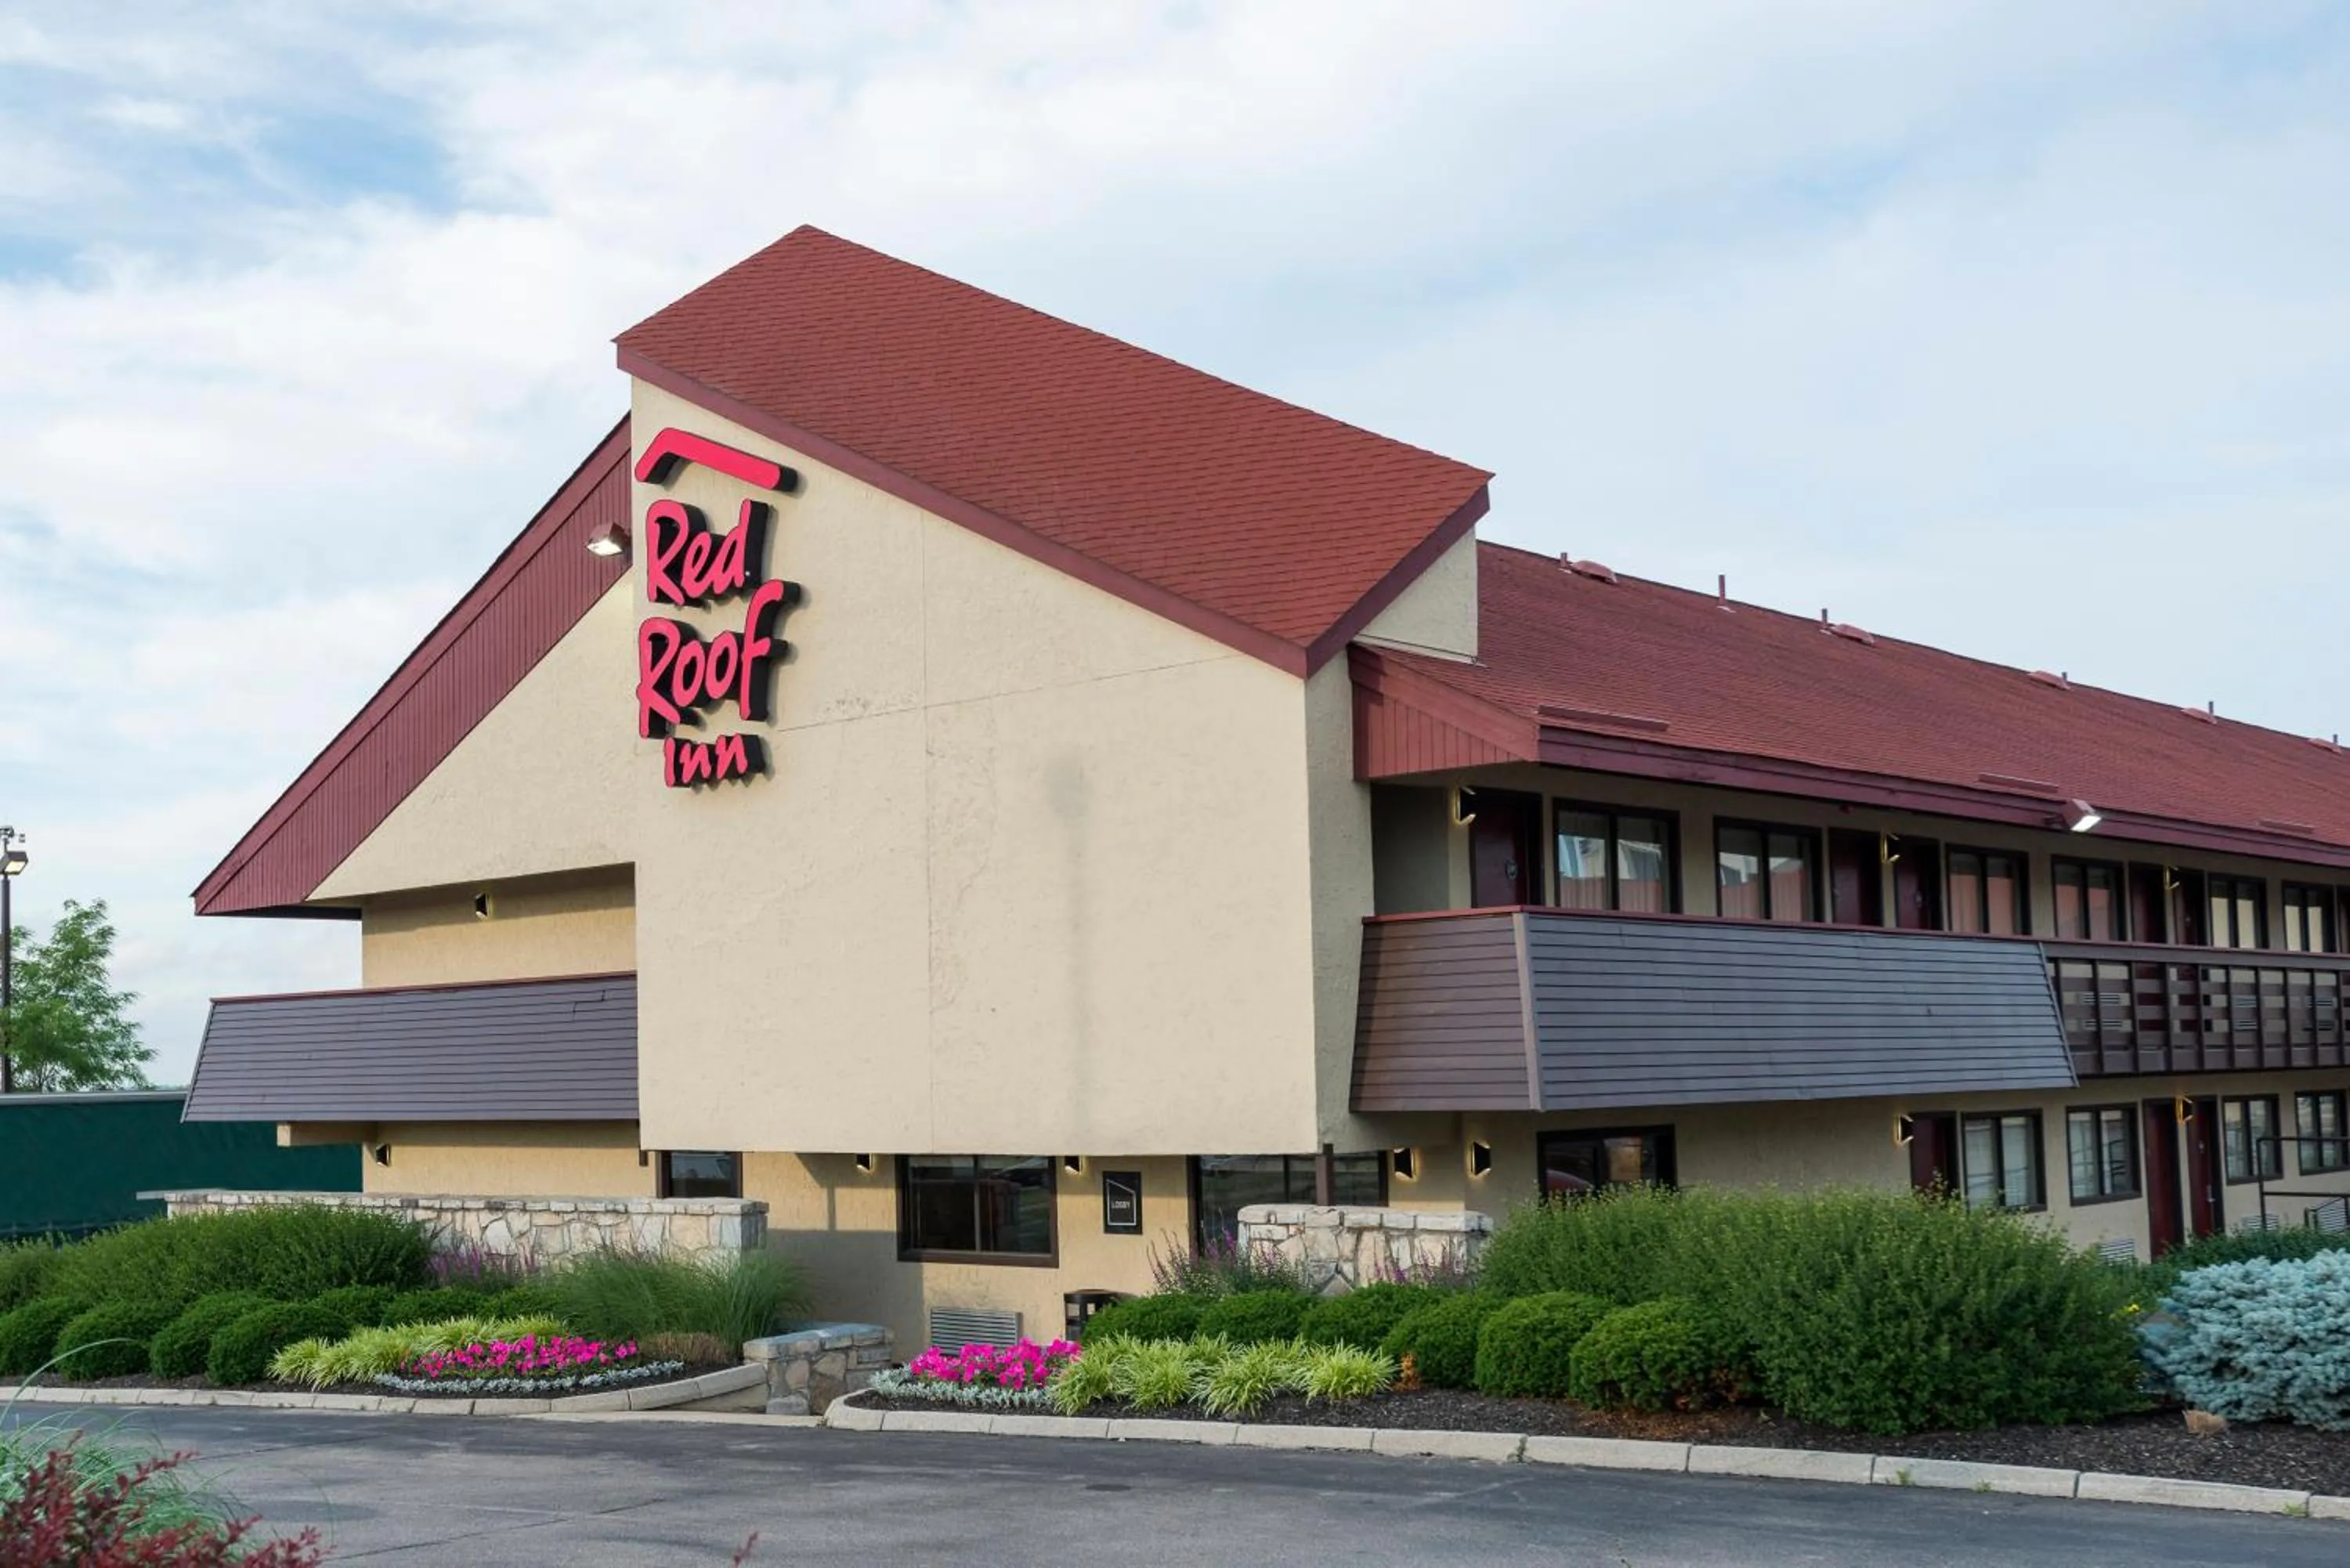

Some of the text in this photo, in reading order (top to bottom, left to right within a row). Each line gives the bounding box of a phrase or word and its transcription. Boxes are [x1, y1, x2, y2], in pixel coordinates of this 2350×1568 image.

[645, 498, 752, 605] Red
[635, 579, 784, 739] Roof
[663, 733, 749, 788] Inn
